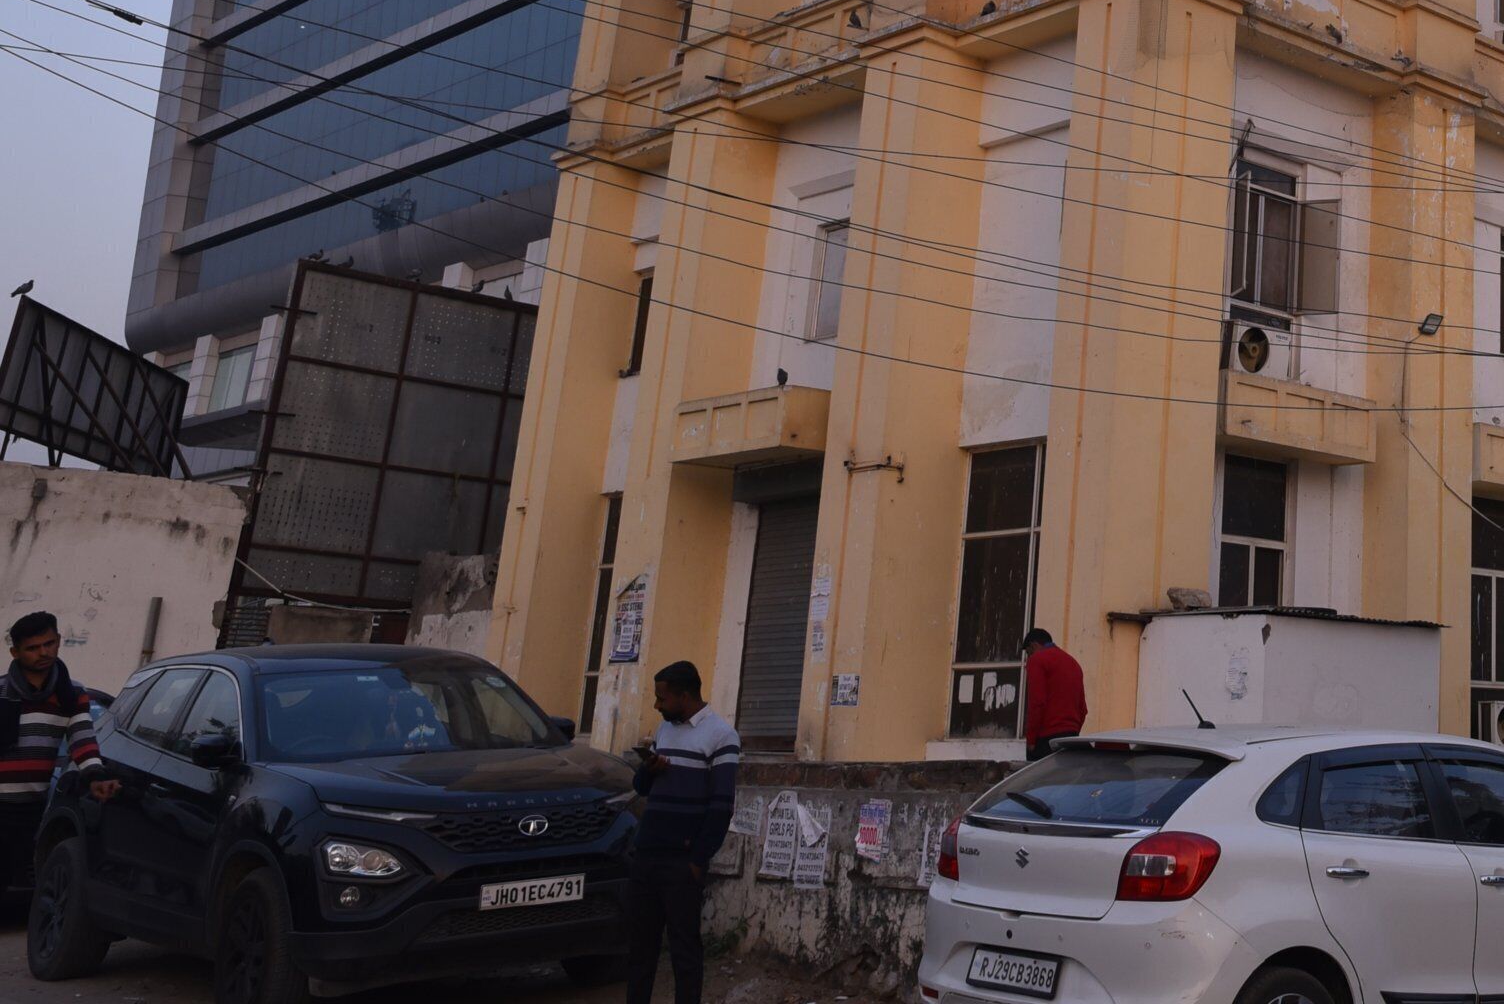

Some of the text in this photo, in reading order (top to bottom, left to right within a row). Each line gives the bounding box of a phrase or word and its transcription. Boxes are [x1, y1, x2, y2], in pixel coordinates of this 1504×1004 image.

[785, 823, 794, 837] PG
[490, 879, 582, 906] JH01EC4791
[979, 956, 1054, 988] RJ29CB3868
